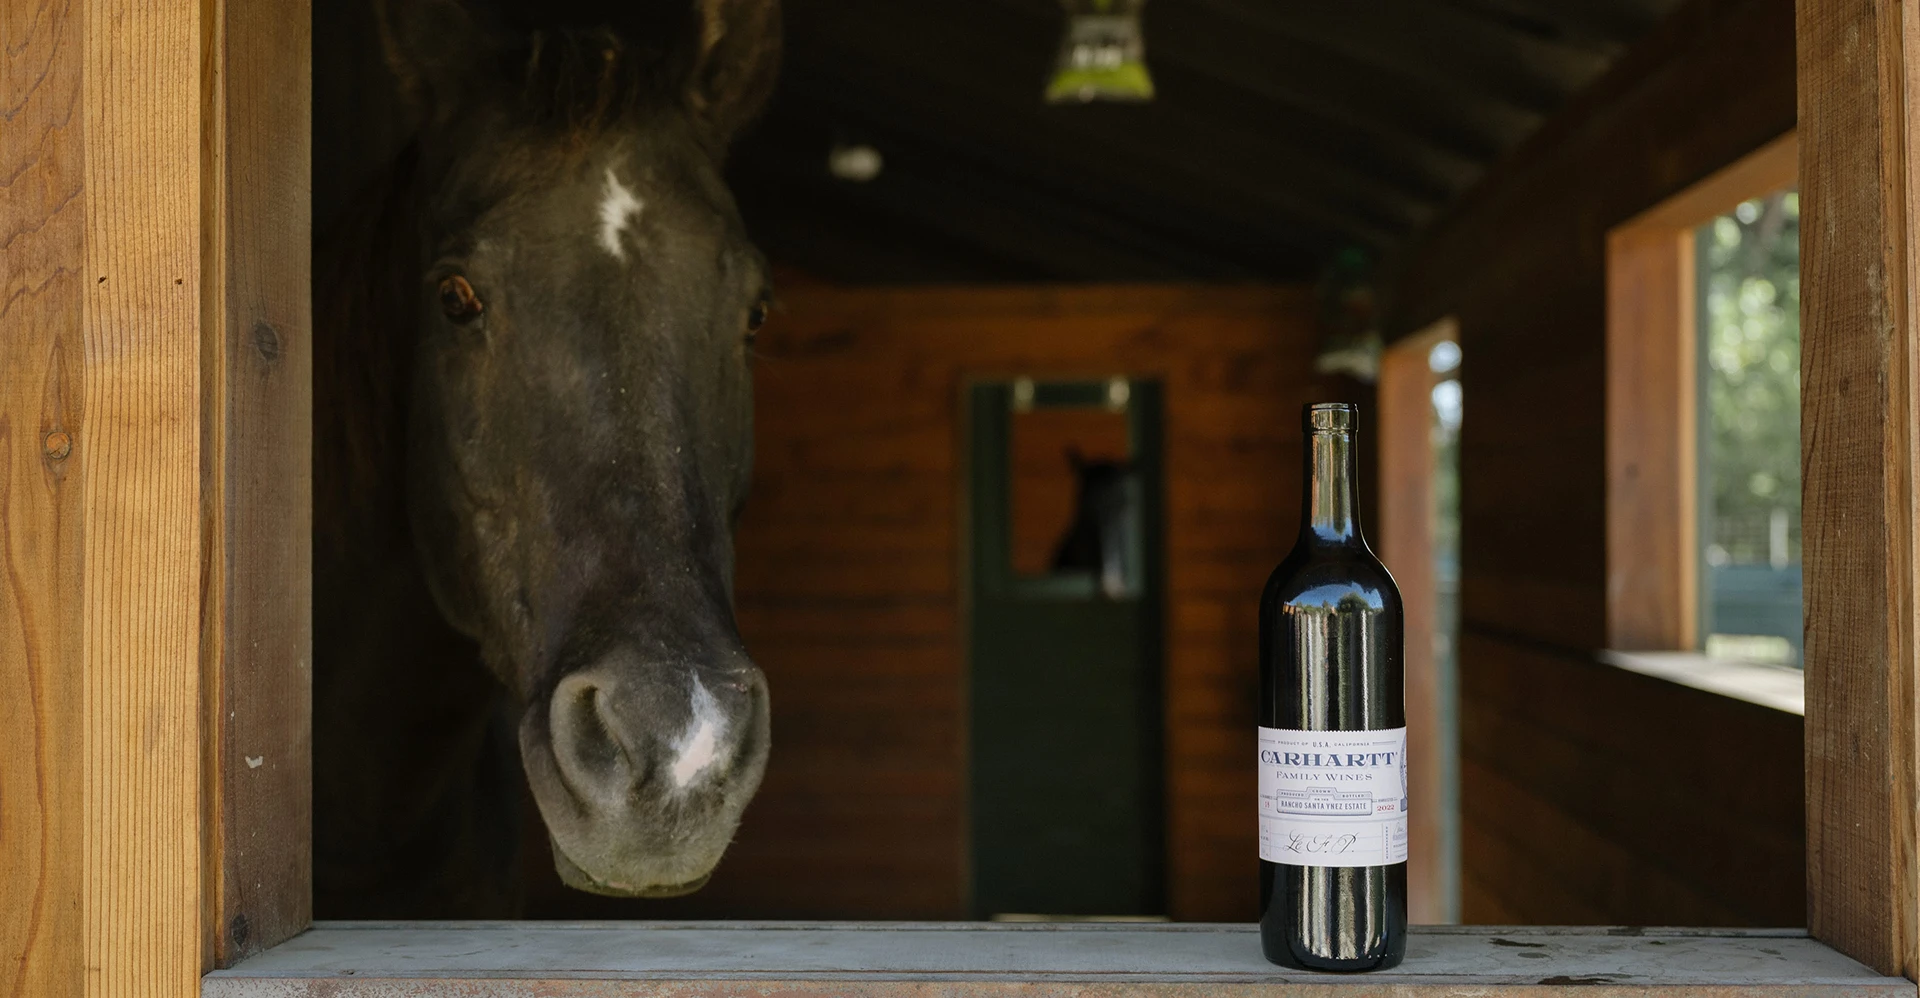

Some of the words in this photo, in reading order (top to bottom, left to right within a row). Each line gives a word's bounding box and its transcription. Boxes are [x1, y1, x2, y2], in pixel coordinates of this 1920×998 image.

[1261, 750, 1395, 767] CARHARTT
[1276, 771, 1321, 781] FAMILY
[1325, 773, 1373, 781] WINES
[1280, 800, 1303, 809] RANCHO
[1304, 802, 1325, 810] SANTA
[1345, 802, 1367, 810] ESTATE
[1376, 804, 1395, 812] 2022
